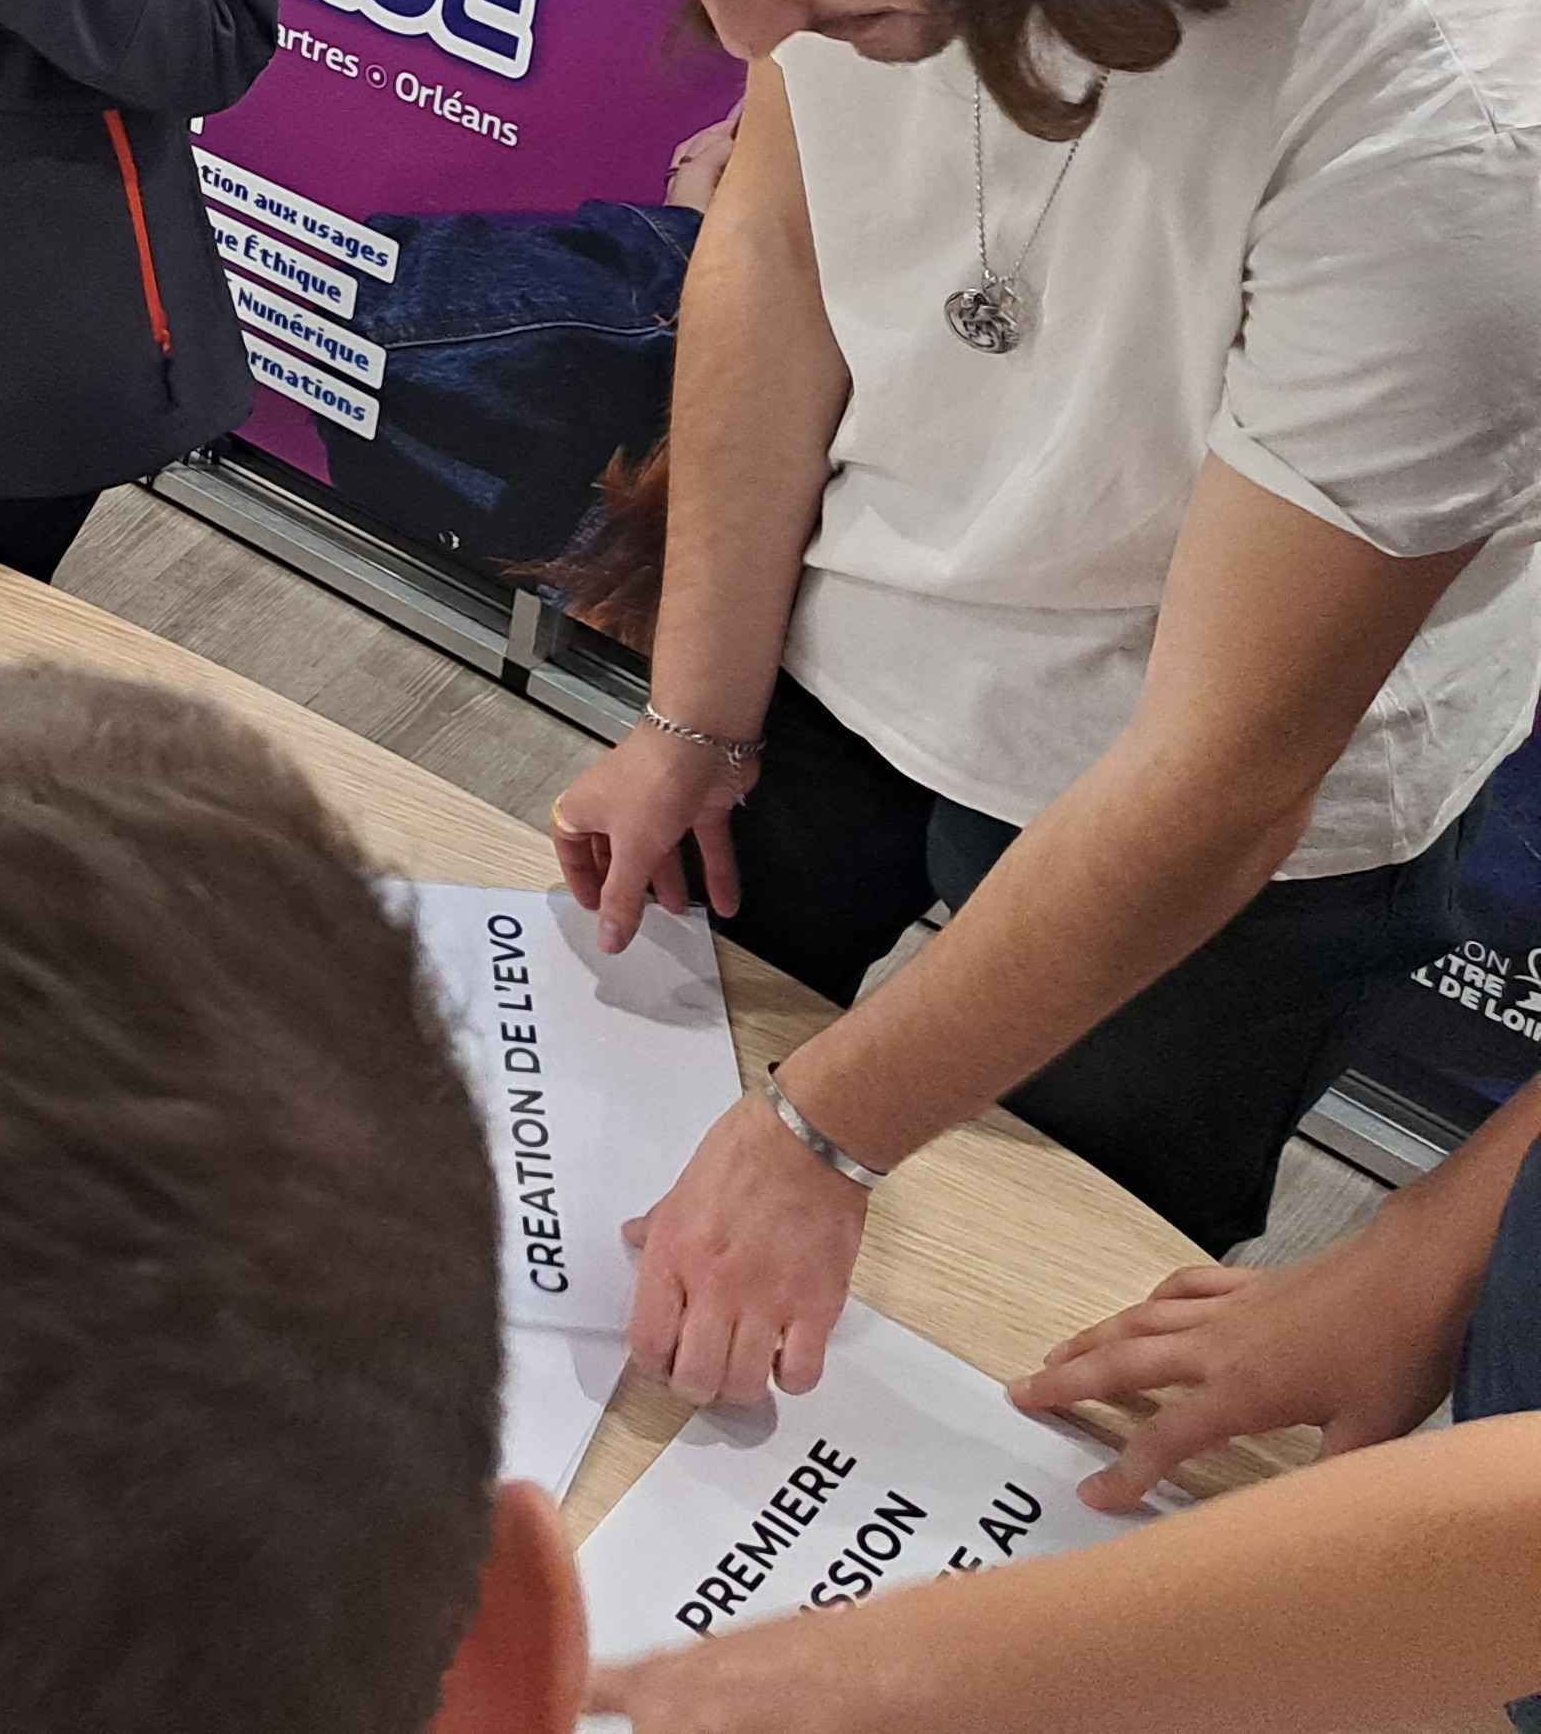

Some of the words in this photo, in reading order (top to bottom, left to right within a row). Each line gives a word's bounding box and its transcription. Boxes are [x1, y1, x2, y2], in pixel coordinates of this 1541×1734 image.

[394, 71, 519, 147] Orléans
[201, 165, 248, 201] tion
[254, 192, 297, 223] aux
[303, 217, 388, 268] usages
[243, 235, 342, 304] Éthique
[237, 286, 369, 372] Numérique
[487, 913, 533, 1012] L'EVO
[1438, 974, 1482, 1010] DE
[1455, 940, 1510, 976] ON
[501, 1023, 544, 1075] DE
[508, 1087, 569, 1295] CREATION
[675, 1438, 857, 1639] PREMIERE
[799, 1491, 929, 1612] SSION
[979, 1482, 1043, 1557] AU
